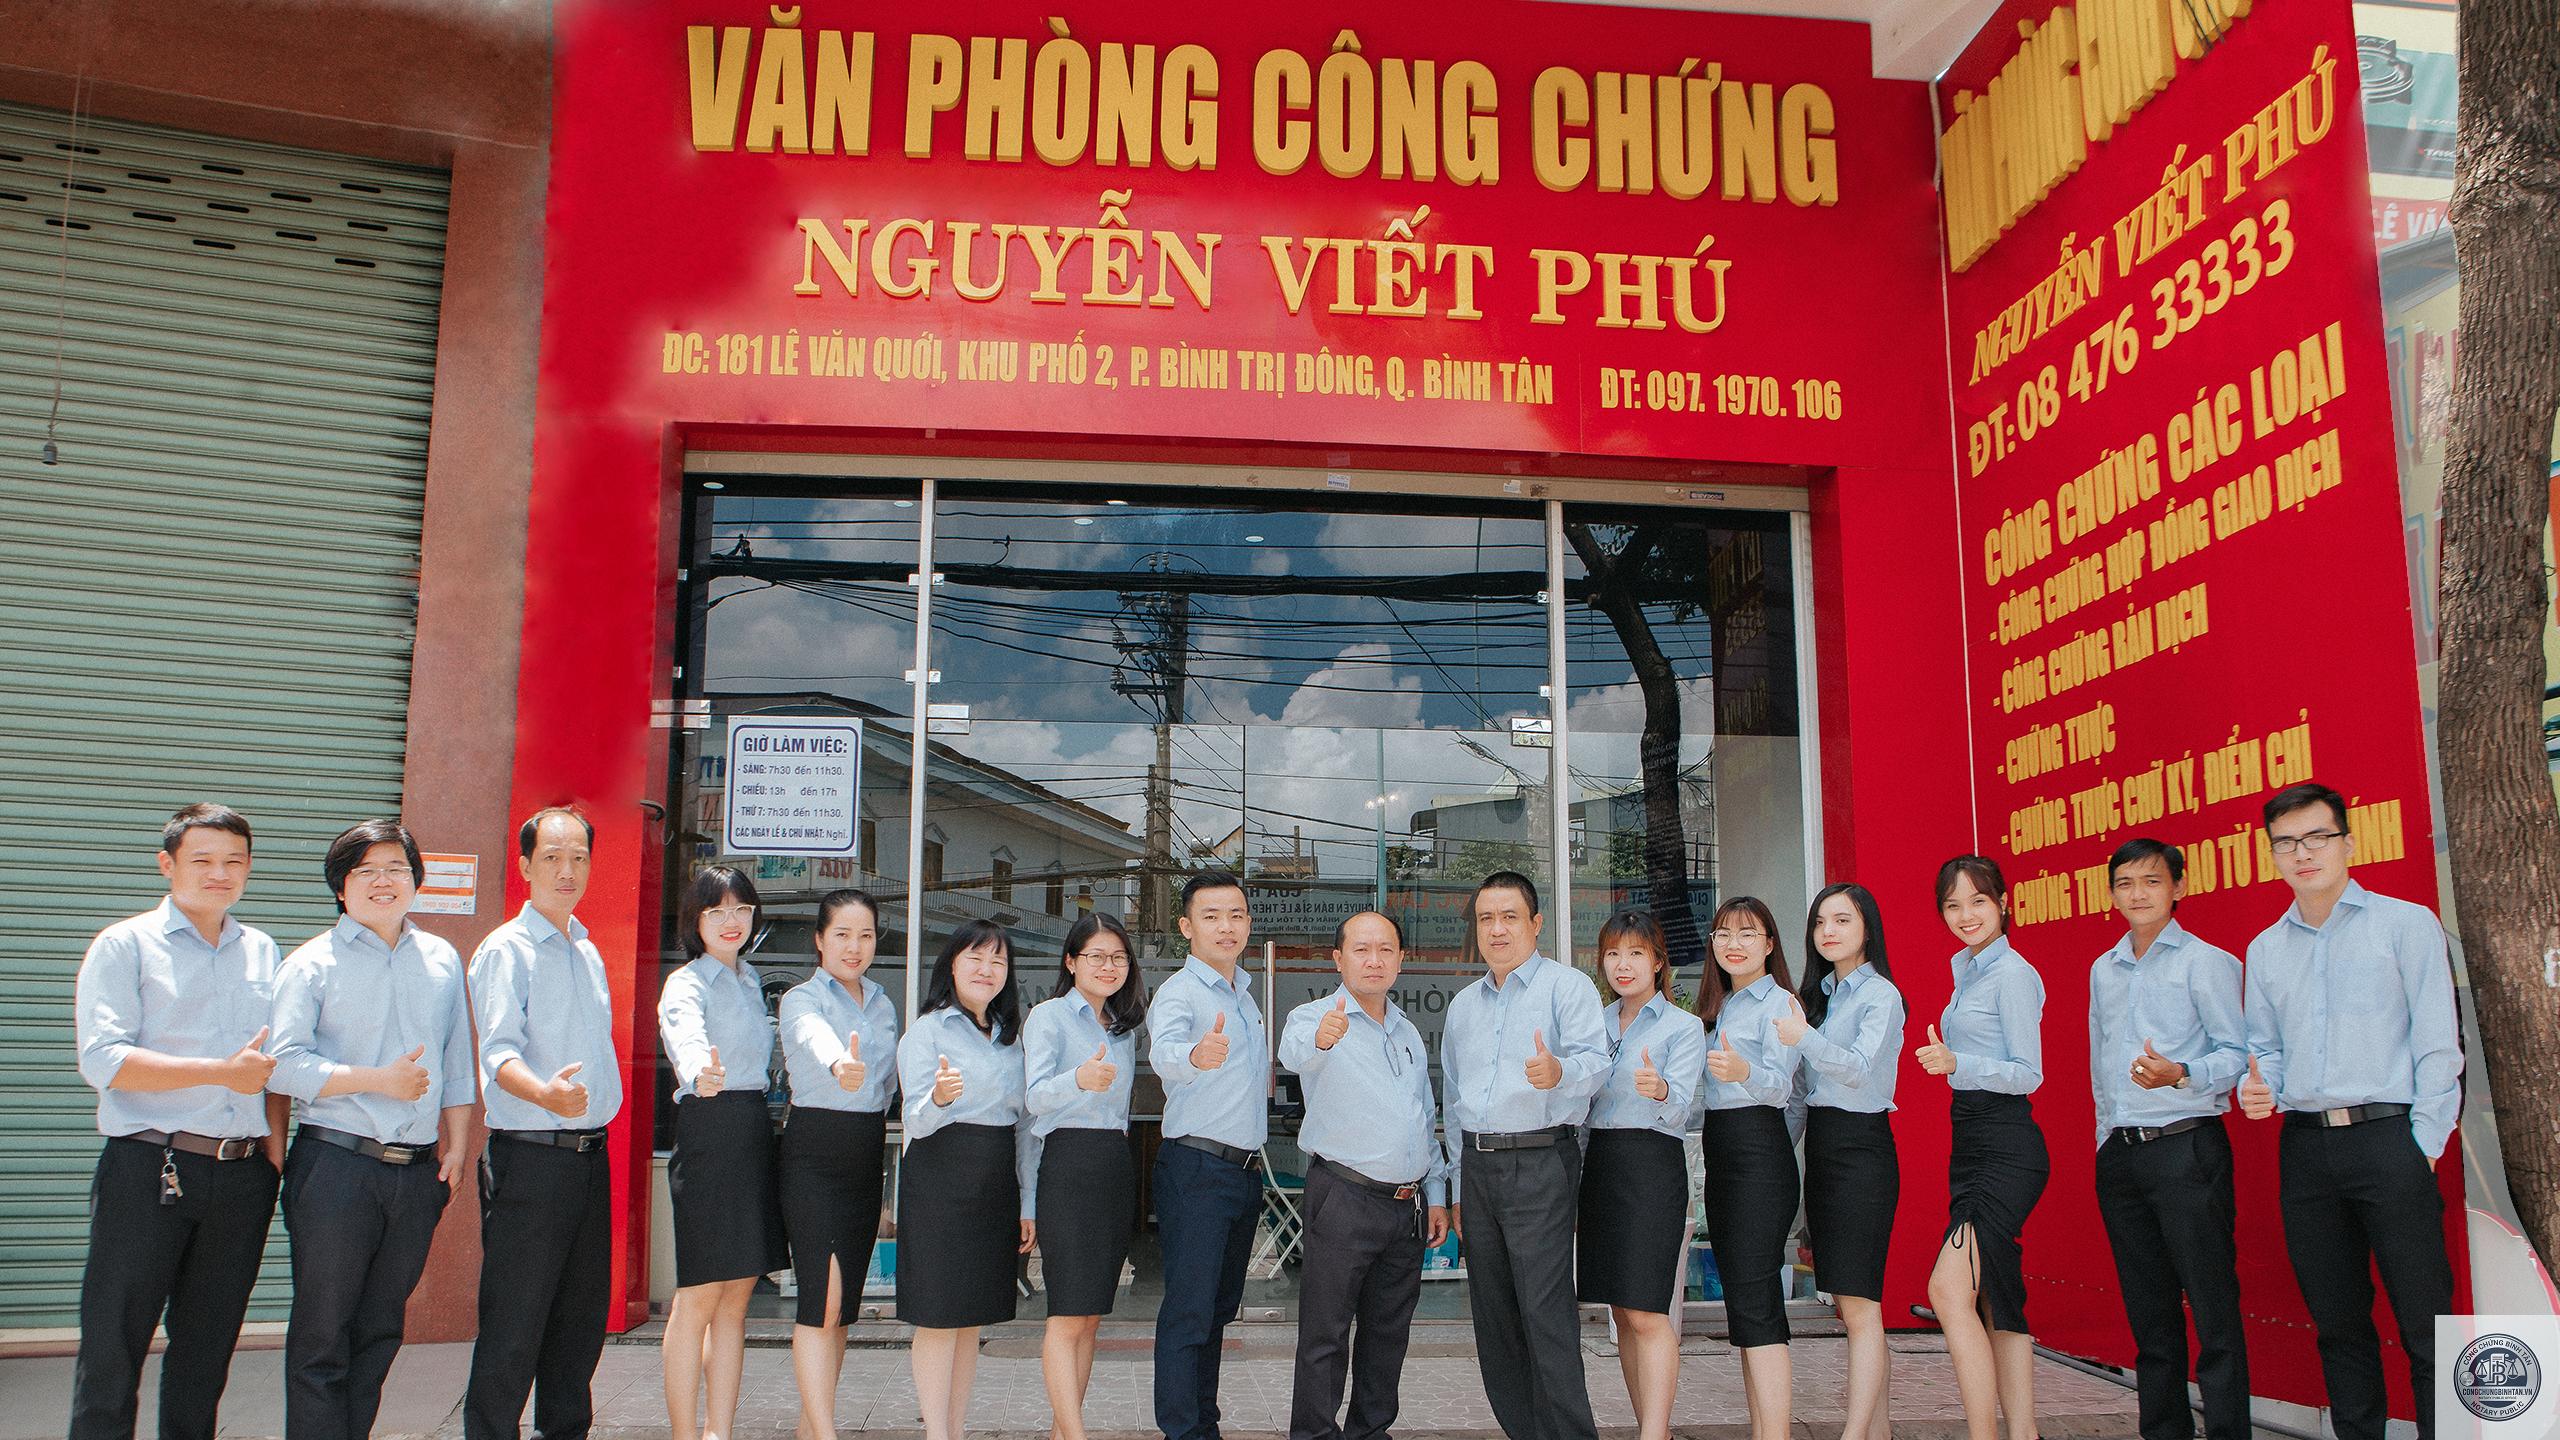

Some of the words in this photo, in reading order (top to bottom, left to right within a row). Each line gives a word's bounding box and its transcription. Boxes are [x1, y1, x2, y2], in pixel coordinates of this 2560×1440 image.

[687, 5, 874, 156] VĂN
[904, 17, 1219, 171] PHÒNG
[1253, 29, 1499, 186] CÔNG
[1532, 58, 1839, 206] CHỨNG
[793, 189, 1221, 309] NGUYỄN
[1260, 205, 1494, 320] VIẾT
[1528, 235, 1732, 333] PHÚ
[1969, 232, 2105, 387] NGUYỄN
[2113, 144, 2211, 277] VIẾT
[2223, 45, 2337, 203] PHÚ
[2068, 304, 2139, 403] 476
[2152, 200, 2295, 350] 33333
[662, 332, 710, 375] ĐC:
[716, 334, 763, 375] 181
[770, 328, 800, 376] LÊ
[808, 329, 866, 378] VĂN
[958, 340, 1018, 382] KHU
[1029, 329, 1087, 386] PHỐ
[1096, 344, 1118, 391] 2,
[1131, 346, 1150, 387] P.
[1160, 341, 1228, 390] BÌNH
[1237, 349, 1285, 399] TRỊ
[1295, 346, 1381, 401] ĐÔNG,
[1386, 356, 1415, 403] Q.
[1423, 353, 1491, 403] BÌNH
[1499, 356, 1553, 405] TÂN
[1600, 367, 1641, 409] ĐT:
[1647, 371, 1705, 412] 097.
[1713, 374, 1787, 417] 1970.
[1791, 378, 1842, 420] 106
[1984, 499, 2052, 587] CÔNG
[2057, 433, 2160, 546] CHỨNG
[2167, 383, 2243, 484] CÁC
[2250, 321, 2347, 440] LOẠI
[2043, 550, 2105, 624] CHỨNG
[2106, 527, 2146, 594] HỢP
[2150, 497, 2210, 572] ĐỒNG
[2213, 465, 2273, 540] GIAO
[2275, 428, 2342, 512] DỊCH
[2048, 628, 2110, 695] CHỨNG
[2112, 602, 2154, 670] BẢN
[2155, 582, 2209, 654] DỊCH
[744, 734, 769, 752] GIỜ
[773, 734, 805, 753] LÀM
[810, 735, 848, 757] VIỆC:
[769, 766, 791, 775] 7h30
[794, 765, 812, 775] đến
[2065, 700, 2116, 765] THỰC
[2070, 776, 2120, 841] THỰC
[2122, 760, 2166, 826] CHỮ
[2203, 724, 2263, 806] ĐIỂM
[2265, 707, 2313, 788] CHỈ
[768, 807, 790, 817] 7h30
[793, 807, 811, 817] đến
[770, 786, 786, 796] 13h
[800, 786, 818, 796] đến
[821, 787, 838, 796] 17h
[2217, 822, 2251, 889] TỪ
